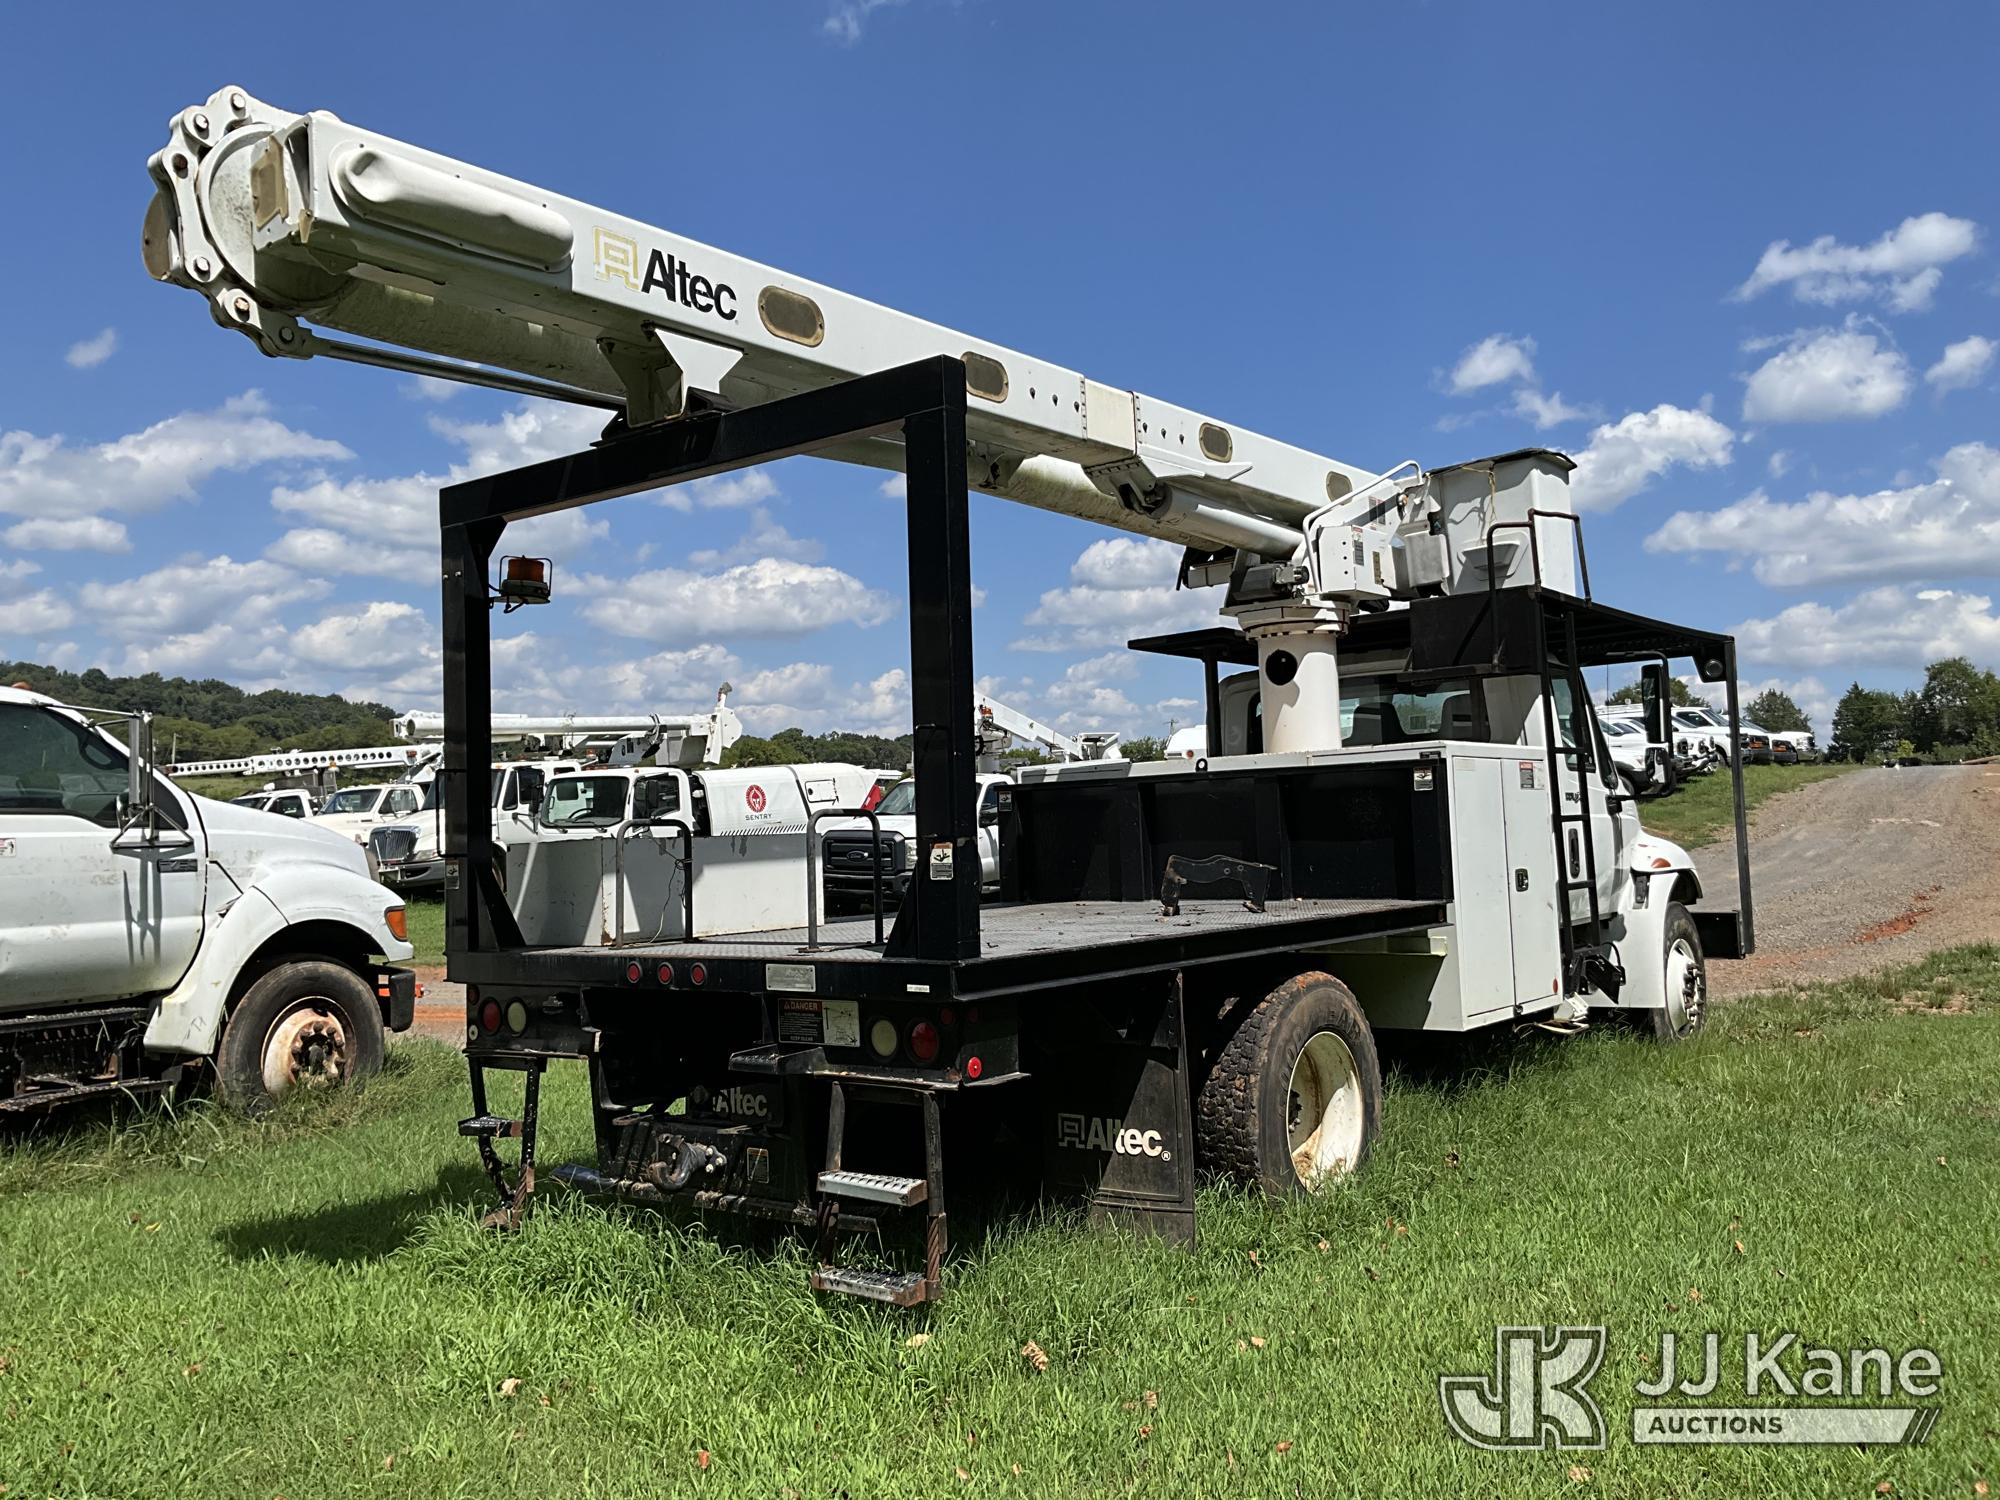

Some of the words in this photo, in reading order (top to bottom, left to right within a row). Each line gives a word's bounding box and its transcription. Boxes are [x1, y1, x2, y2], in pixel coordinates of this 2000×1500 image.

[641, 248, 738, 321] Altec
[790, 1002, 818, 1011] DANGER
[1086, 1117, 1163, 1157] Altec
